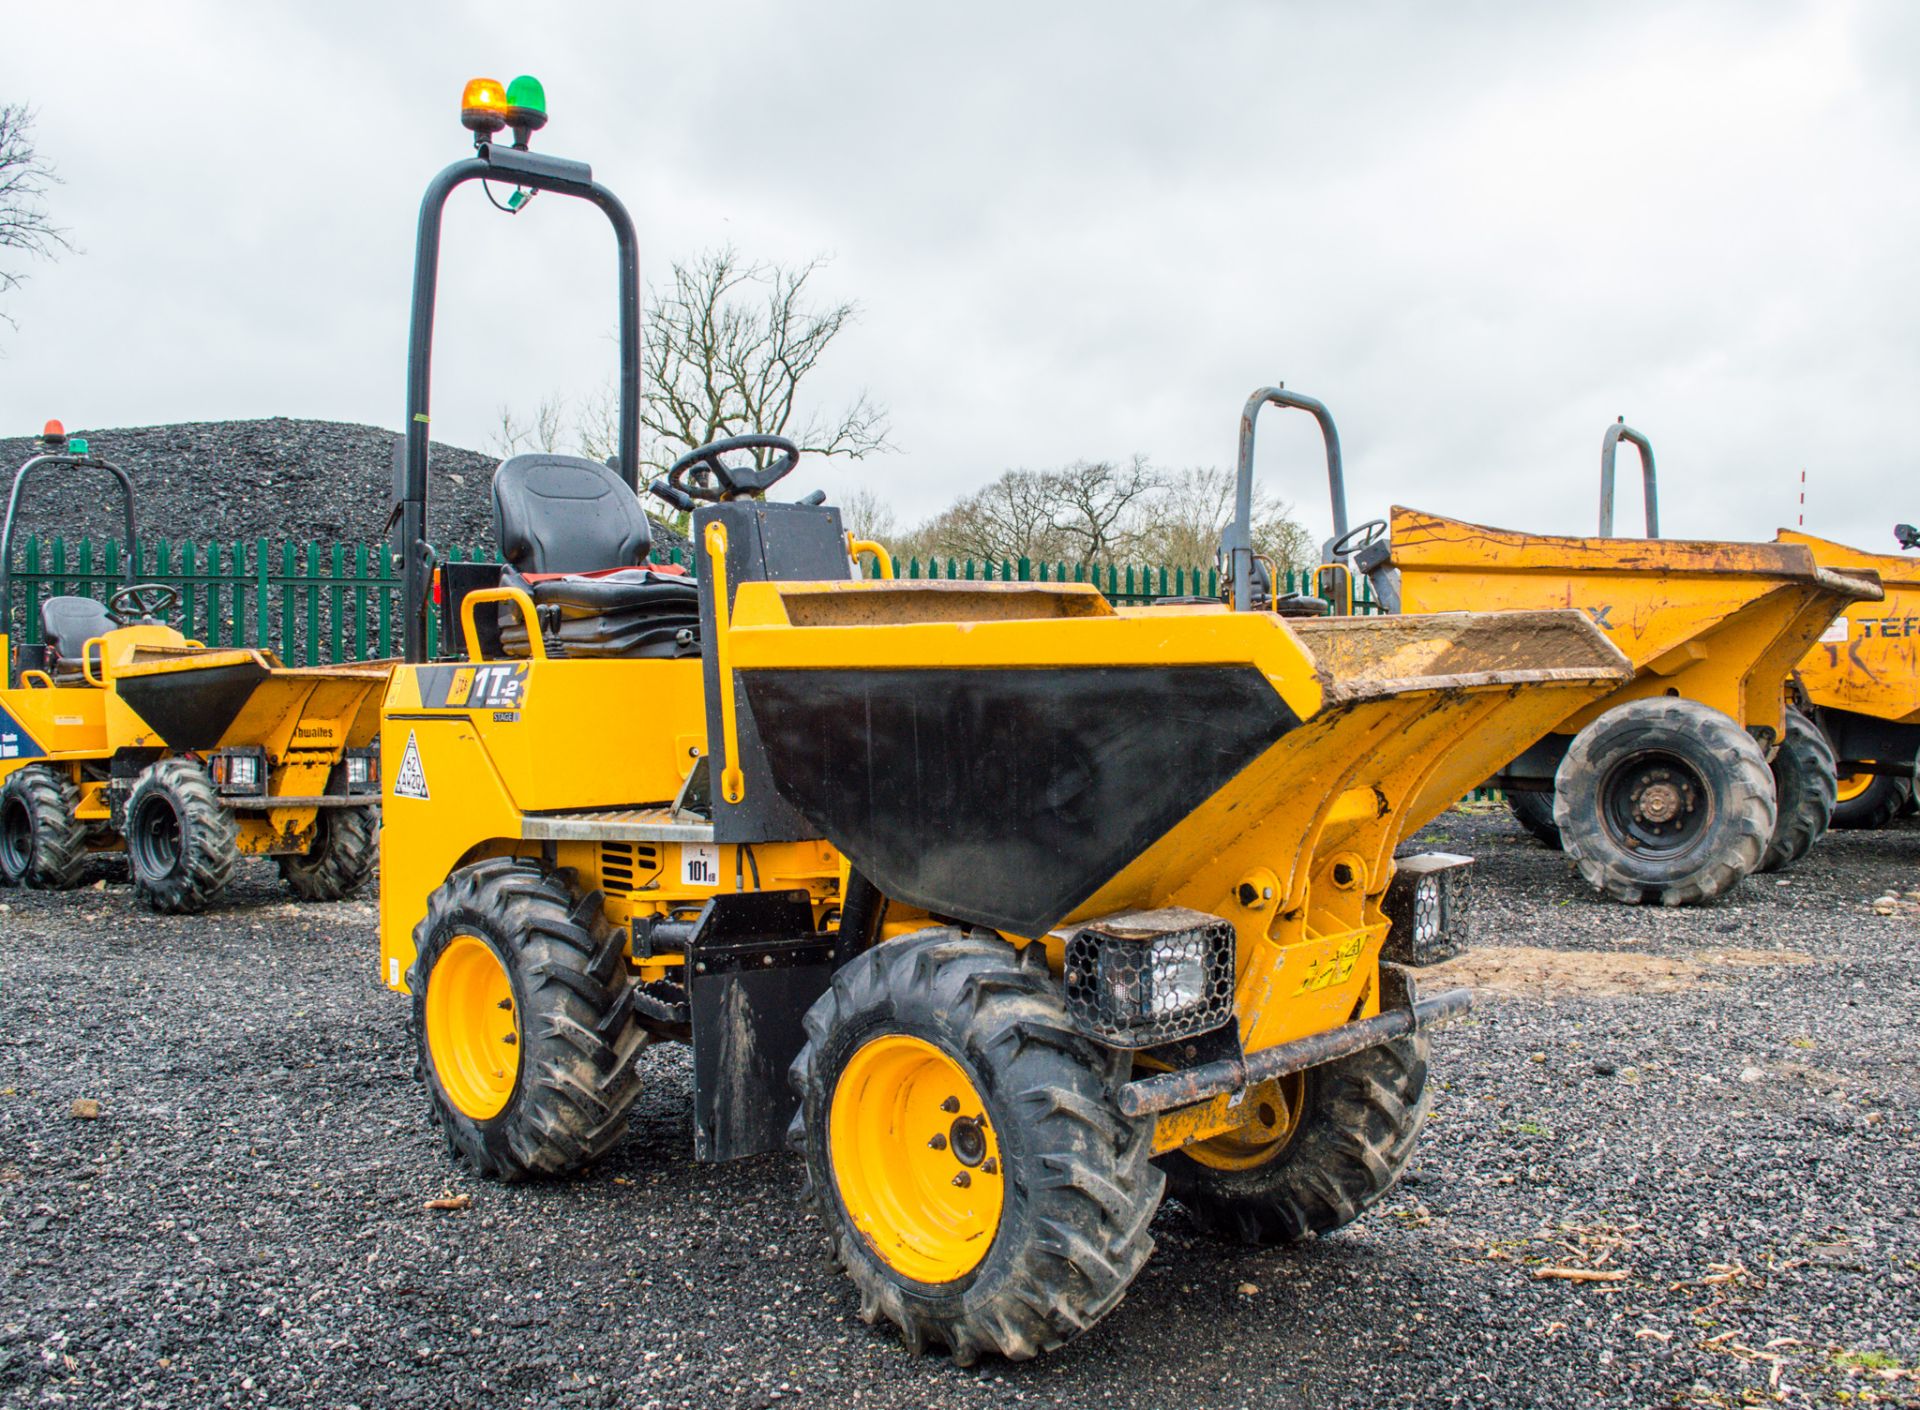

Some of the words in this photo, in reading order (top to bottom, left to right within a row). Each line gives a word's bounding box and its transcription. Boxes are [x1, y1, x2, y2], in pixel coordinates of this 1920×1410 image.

[493, 713, 513, 722] STAGE
[406, 756, 416, 773] 62
[688, 860, 708, 882] 101
